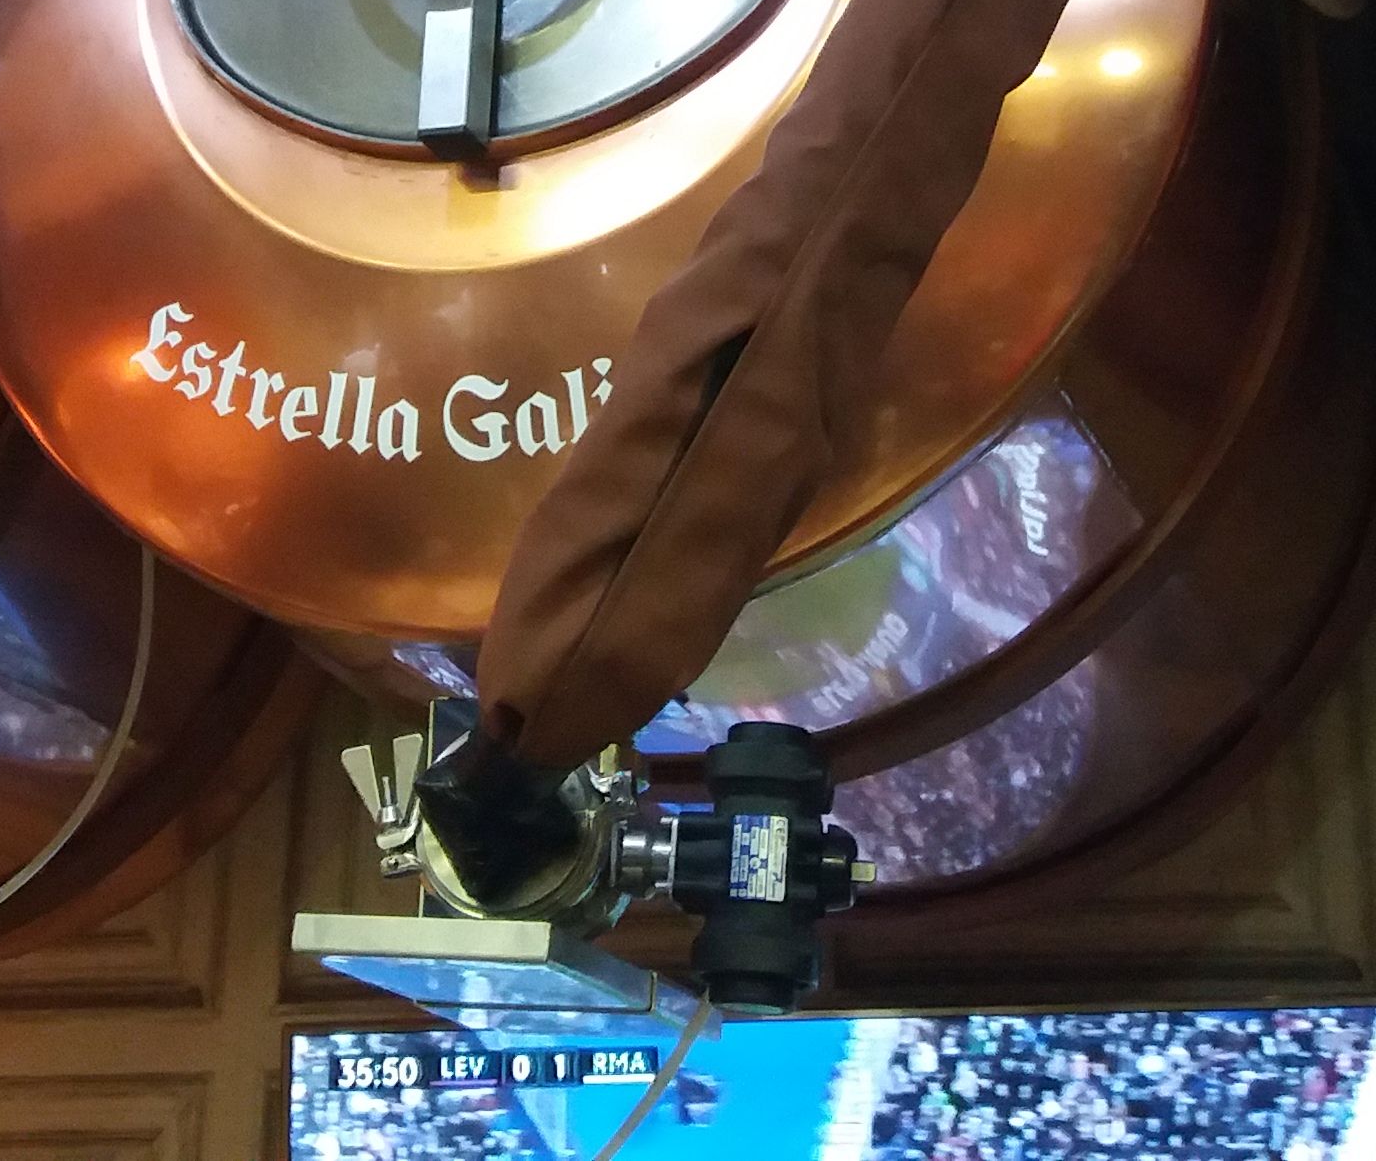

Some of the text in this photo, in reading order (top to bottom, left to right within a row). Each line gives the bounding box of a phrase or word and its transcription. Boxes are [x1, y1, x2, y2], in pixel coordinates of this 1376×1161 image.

[129, 301, 614, 463] Estrella Gali
[337, 1051, 646, 1088] 35:50 LEV 0 1 RMA
